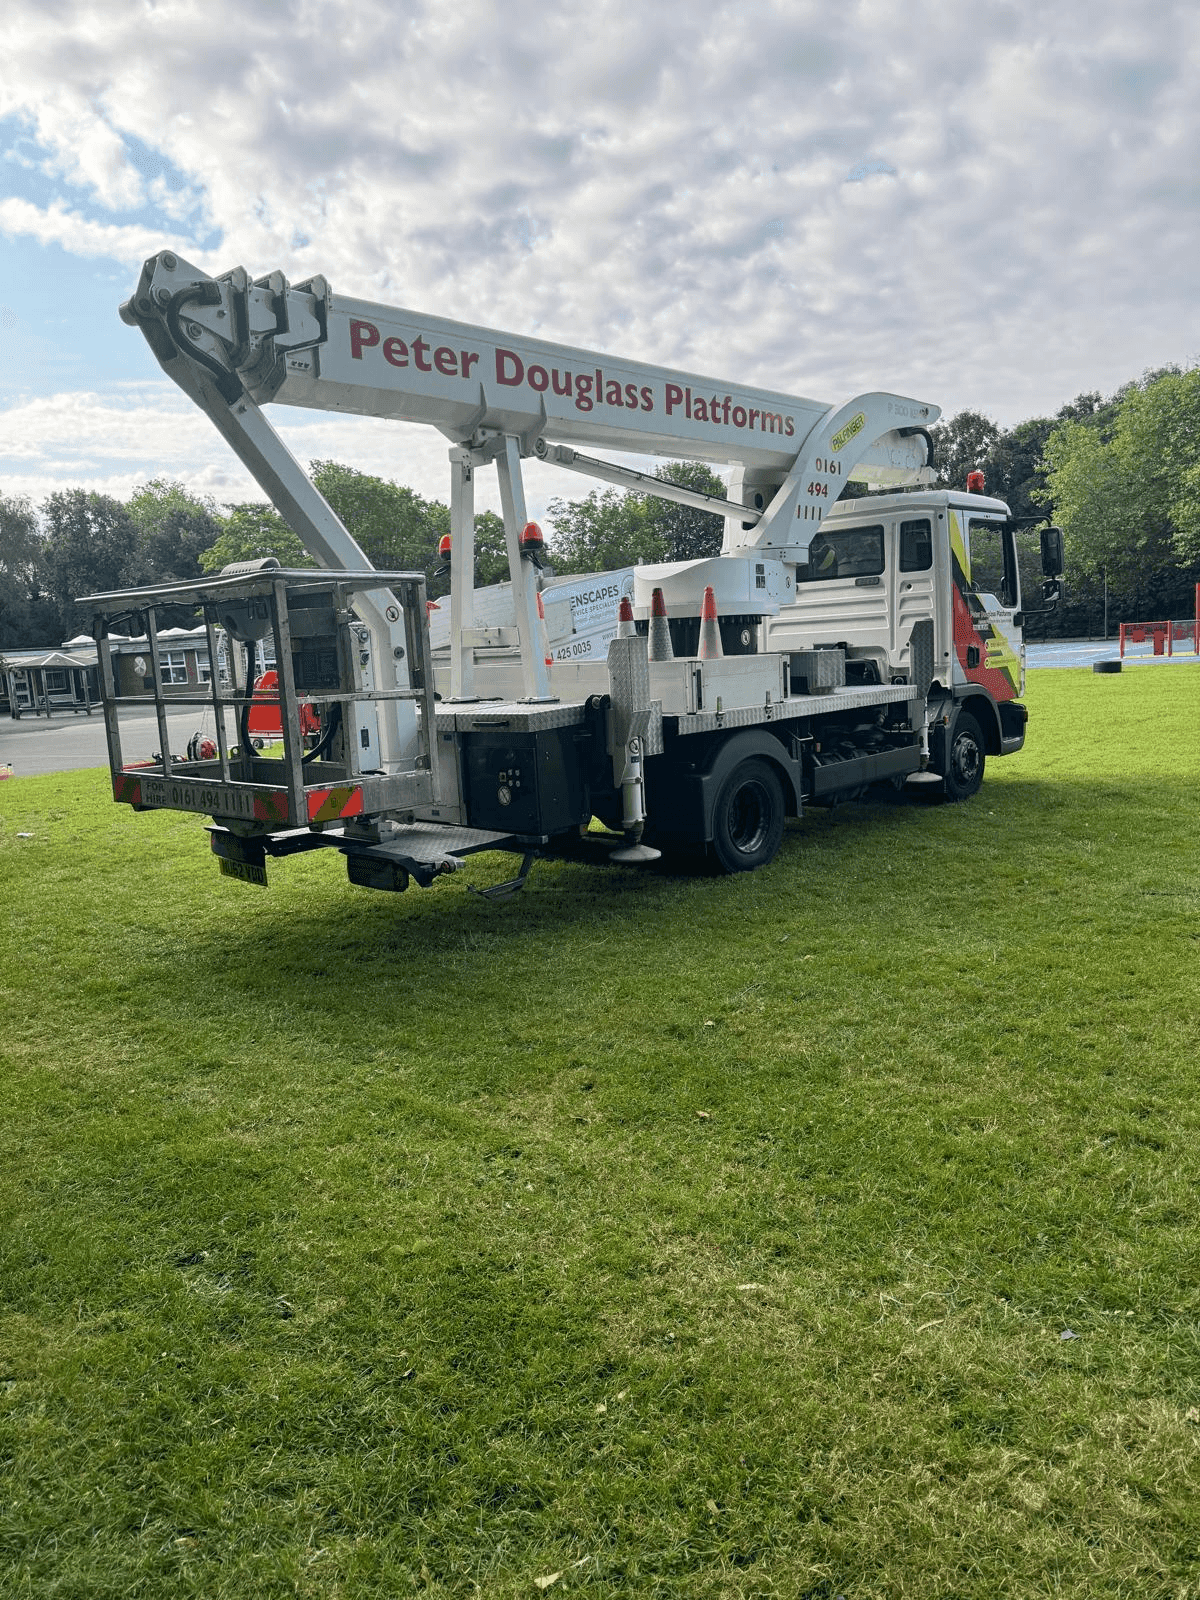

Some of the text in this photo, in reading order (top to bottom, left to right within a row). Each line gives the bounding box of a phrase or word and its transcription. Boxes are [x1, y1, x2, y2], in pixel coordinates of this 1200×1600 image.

[349, 318, 795, 437] Peter Douglass Platforms
[832, 415, 864, 450] PALFINGER
[816, 457, 841, 475] 0161
[807, 481, 828, 498] 494
[797, 504, 822, 521] 1111
[557, 647, 571, 660] 425
[573, 641, 592, 656] 0035
[146, 782, 165, 793] FOR
[146, 794, 166, 805] HIRE
[172, 787, 251, 813] 0161 494 1111
